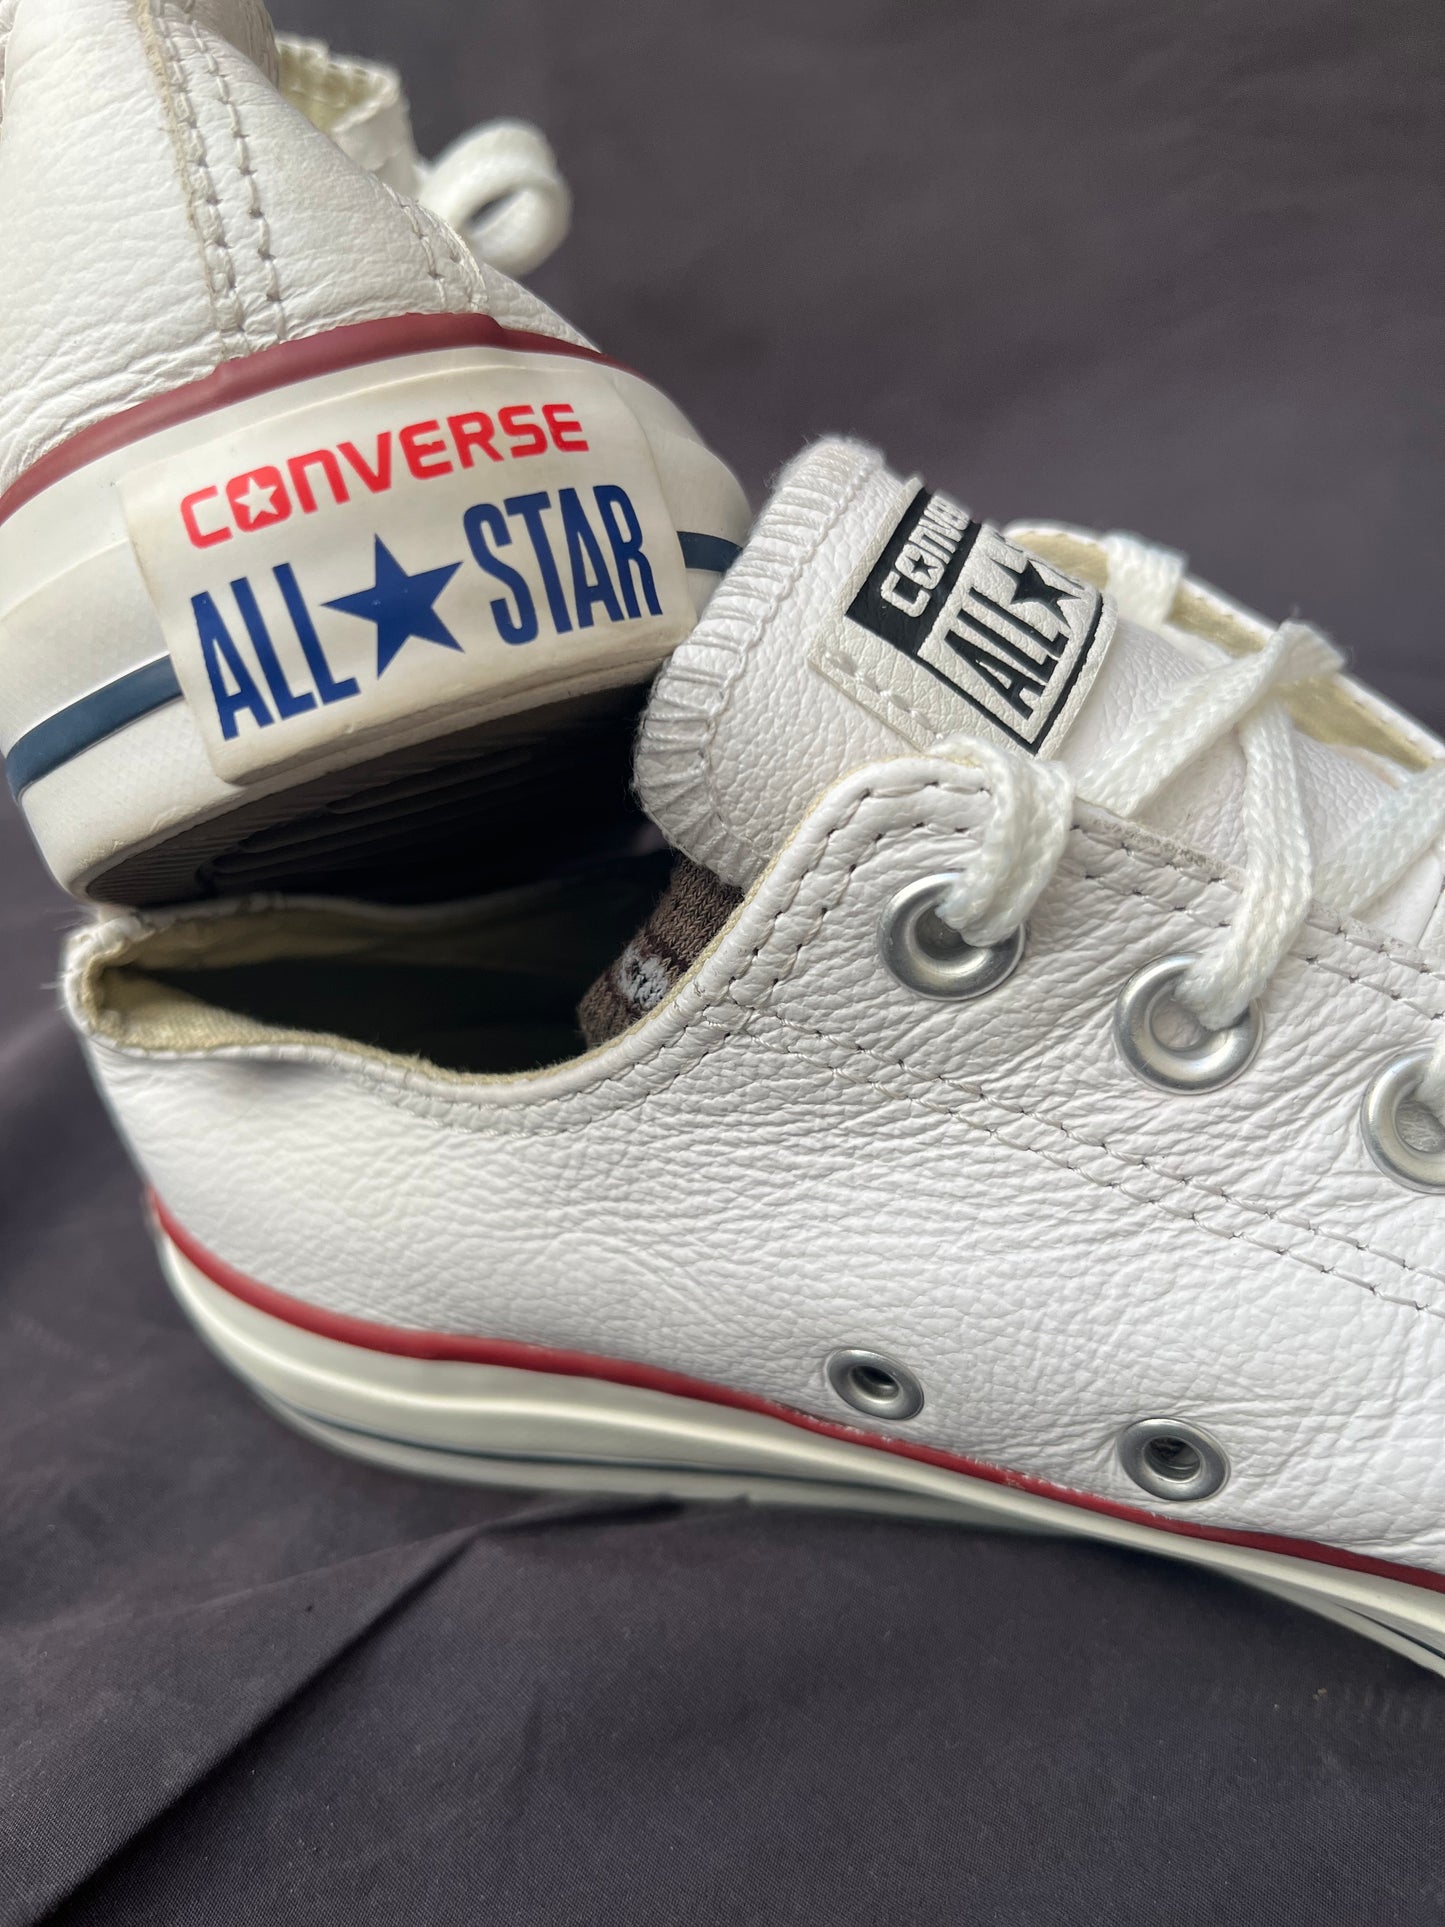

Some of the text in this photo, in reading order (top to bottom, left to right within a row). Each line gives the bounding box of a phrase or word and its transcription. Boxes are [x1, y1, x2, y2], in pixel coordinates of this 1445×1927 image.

[180, 403, 590, 549] CONVERSE
[191, 484, 662, 740] ALL STAR
[880, 494, 972, 618] CONVE
[944, 586, 1070, 721] ALL
